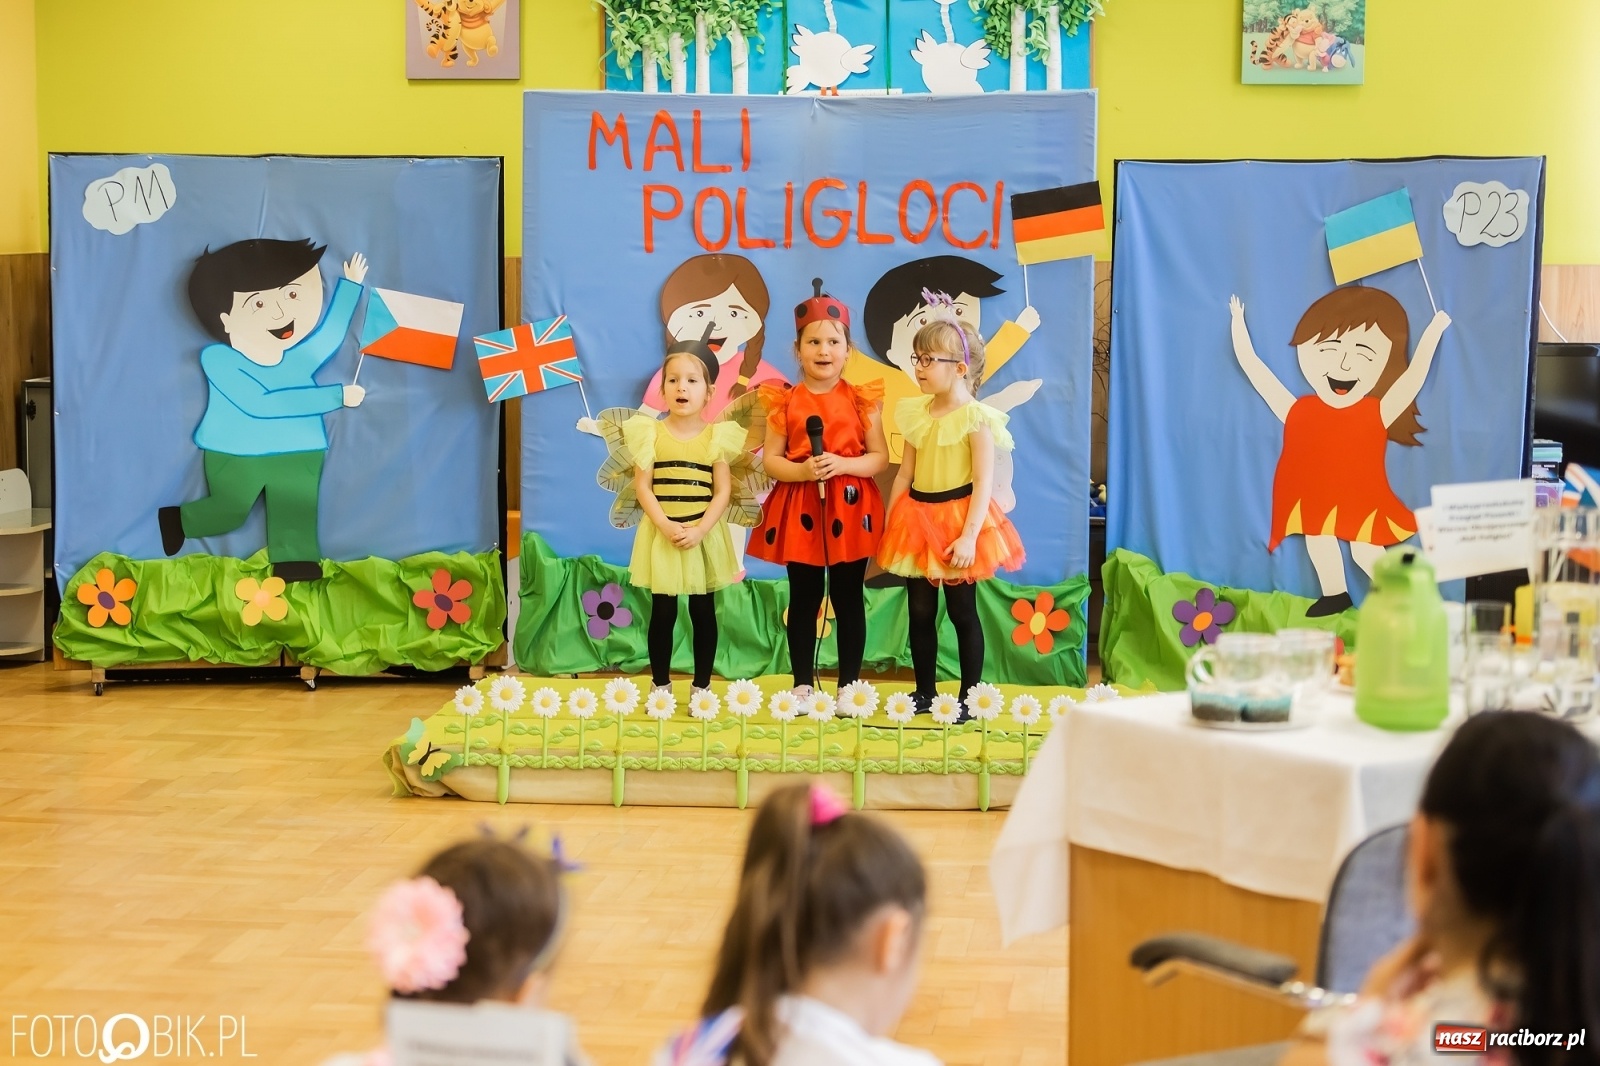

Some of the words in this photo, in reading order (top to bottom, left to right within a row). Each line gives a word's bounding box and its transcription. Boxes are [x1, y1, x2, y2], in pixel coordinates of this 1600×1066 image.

[588, 108, 751, 172] MALI
[97, 169, 169, 222] PM
[643, 177, 1004, 253] POLIGLOCI
[1456, 190, 1519, 238] P23
